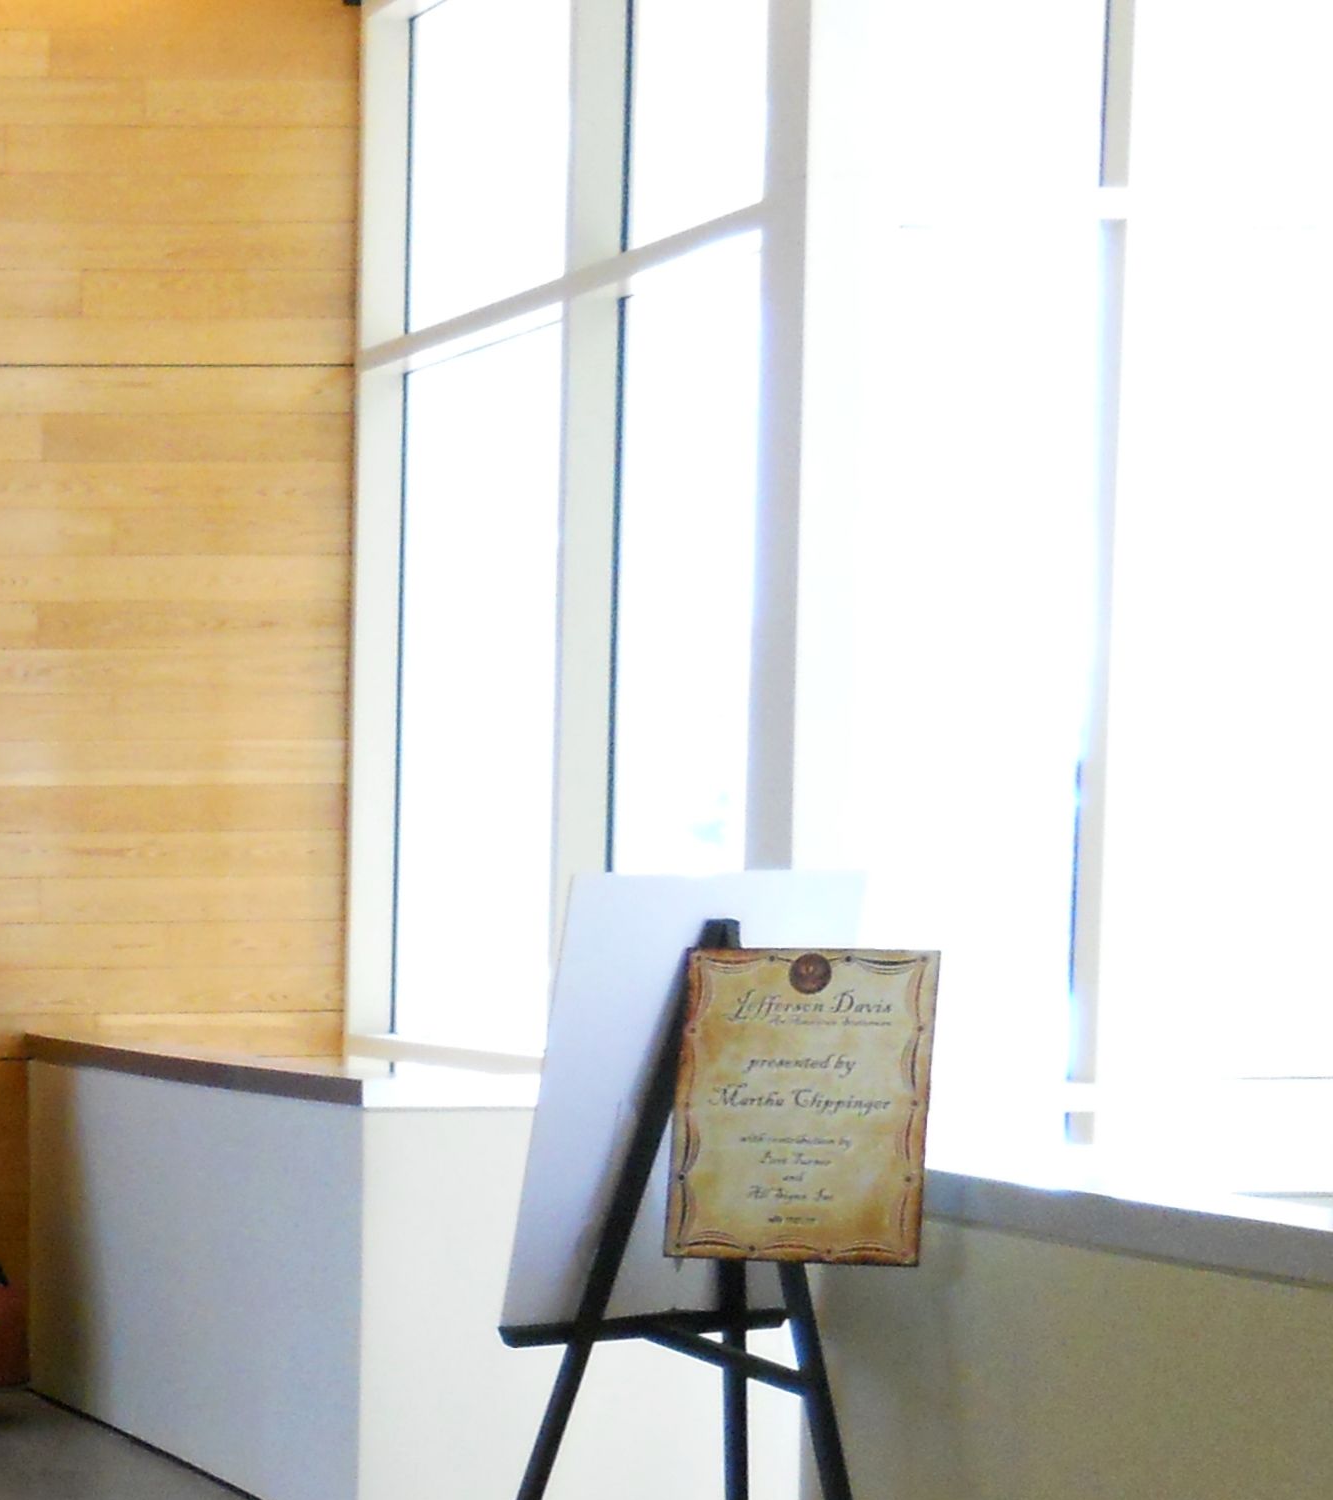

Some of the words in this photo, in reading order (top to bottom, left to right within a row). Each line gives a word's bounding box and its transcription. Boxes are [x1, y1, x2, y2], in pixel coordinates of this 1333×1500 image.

[722, 989, 824, 1022] Jefferson
[830, 990, 893, 1014] Davis
[741, 1054, 835, 1075] presented
[834, 1054, 857, 1079] by
[708, 1082, 785, 1107] Martha
[791, 1088, 891, 1116] Clippinger
